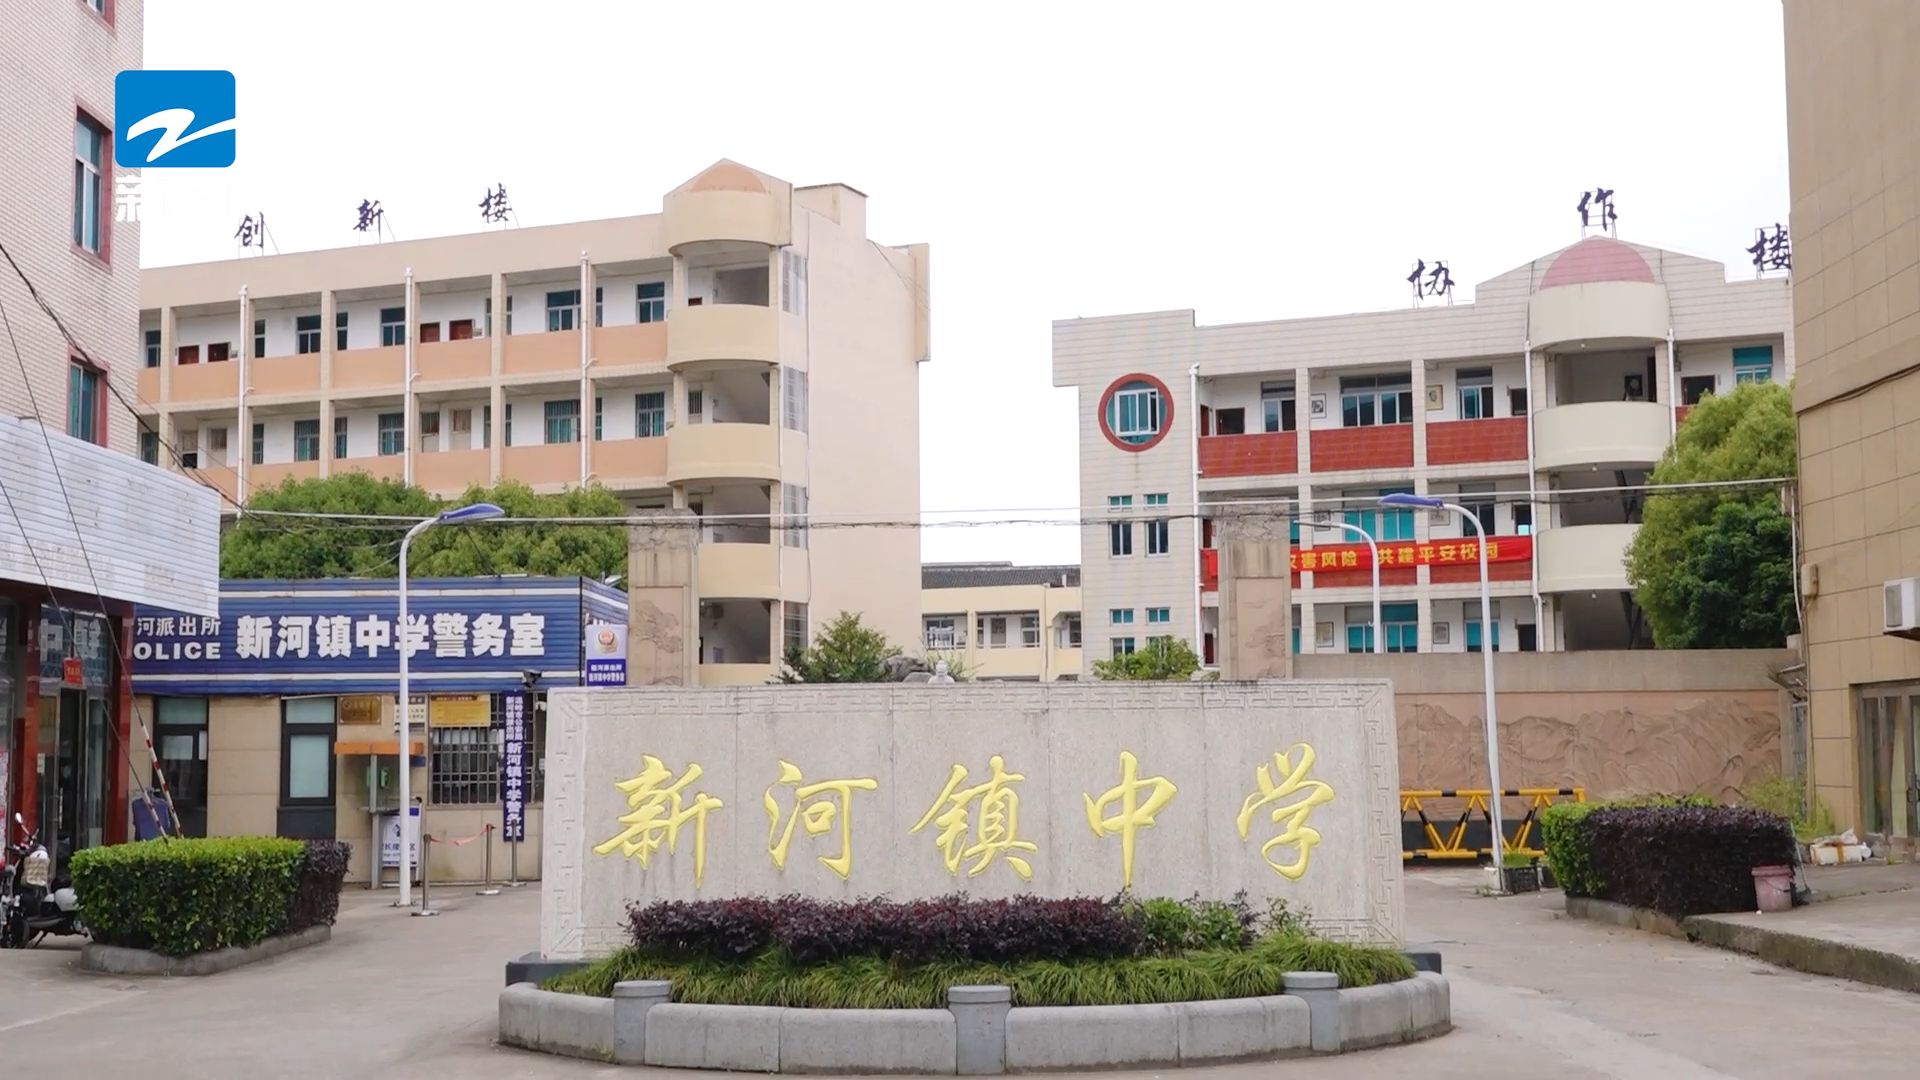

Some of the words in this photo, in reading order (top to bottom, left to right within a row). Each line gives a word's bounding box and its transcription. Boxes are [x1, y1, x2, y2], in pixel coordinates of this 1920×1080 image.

[234, 183, 512, 248] 创新楼
[1407, 187, 1792, 300] 协作楼
[1378, 541, 1498, 565] 共建平安校园
[137, 616, 221, 637] 河派出所
[236, 612, 545, 658] 新河镇中学警务室
[133, 641, 221, 660] OLICE
[593, 742, 1336, 890] 新河镇中学
